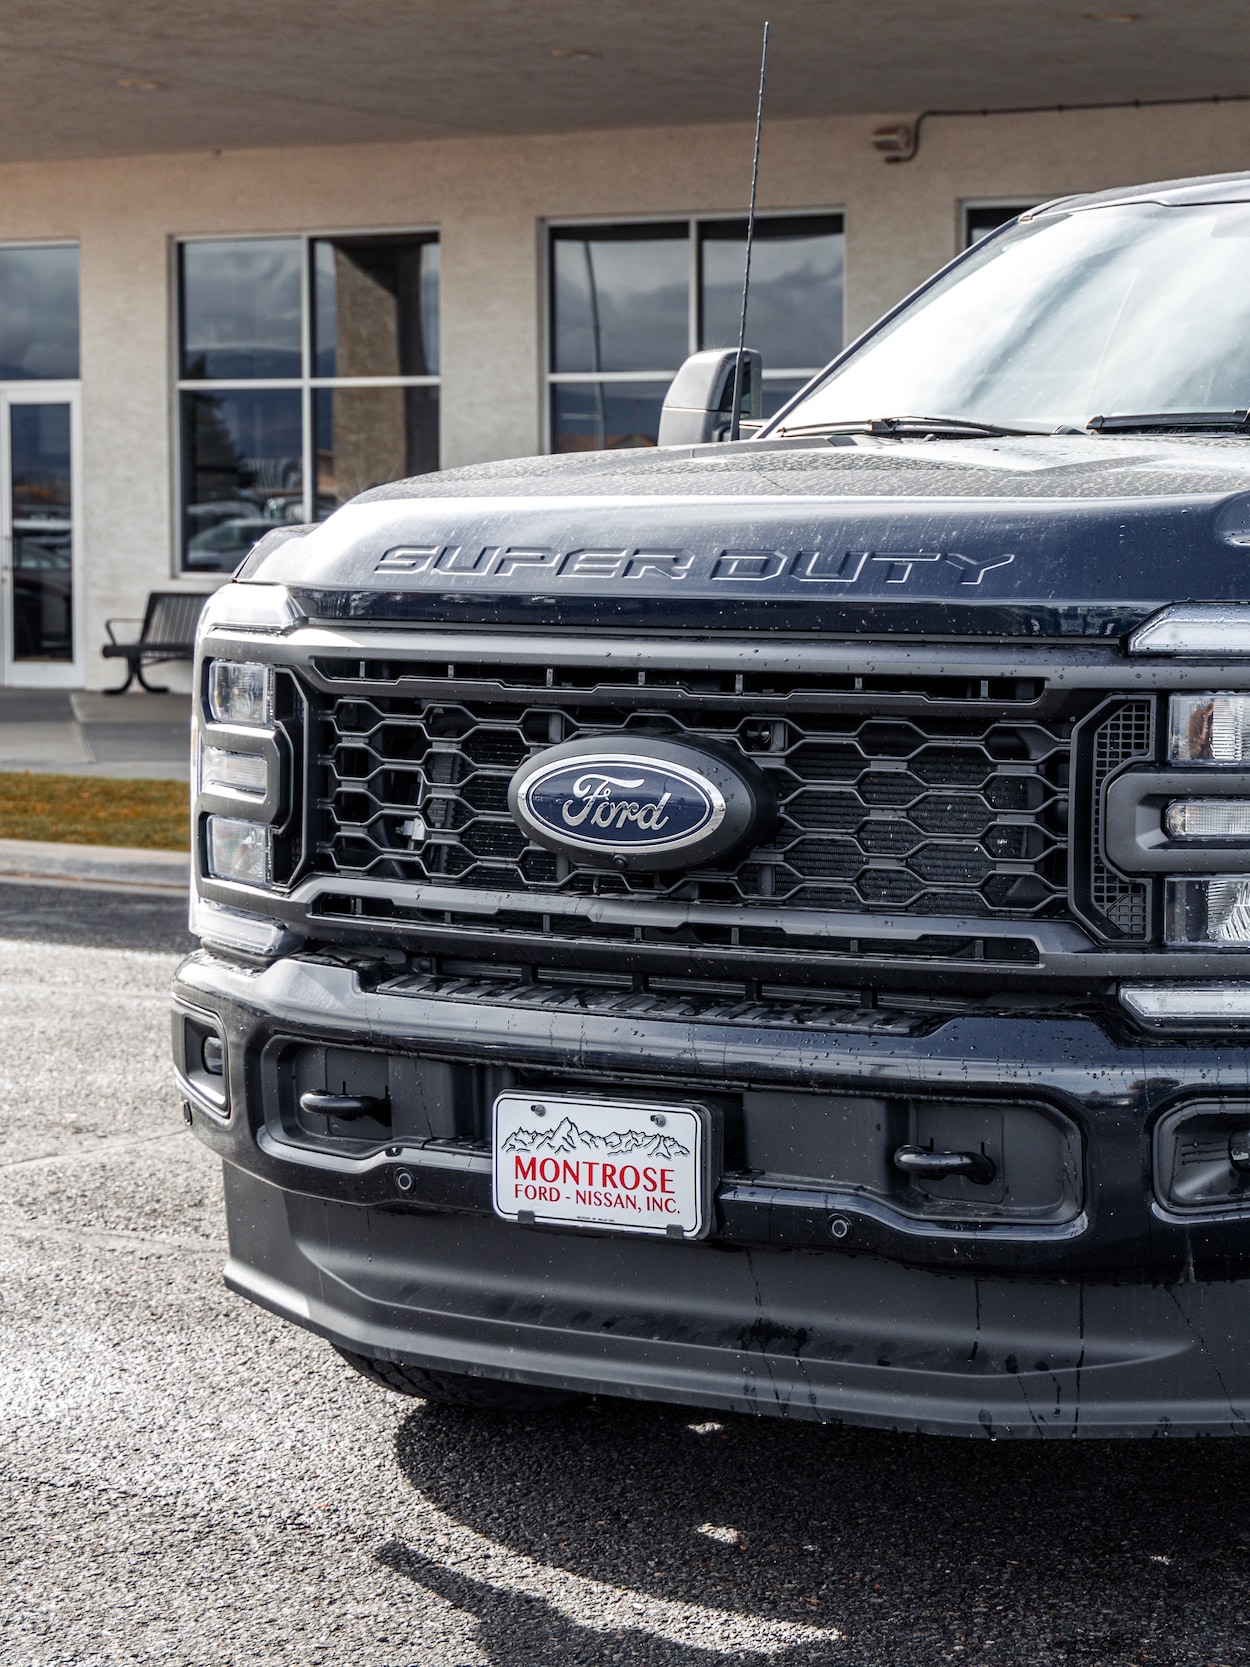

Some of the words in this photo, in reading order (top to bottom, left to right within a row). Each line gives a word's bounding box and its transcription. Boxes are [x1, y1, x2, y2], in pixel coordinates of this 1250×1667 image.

[374, 544, 696, 580] SUPER
[709, 547, 1015, 585] DUTY
[561, 773, 673, 831] Ford
[514, 1155, 676, 1194] MONTROSE
[514, 1183, 561, 1202] FORD
[575, 1189, 643, 1213] NISSAN,
[646, 1195, 681, 1215] INC.
